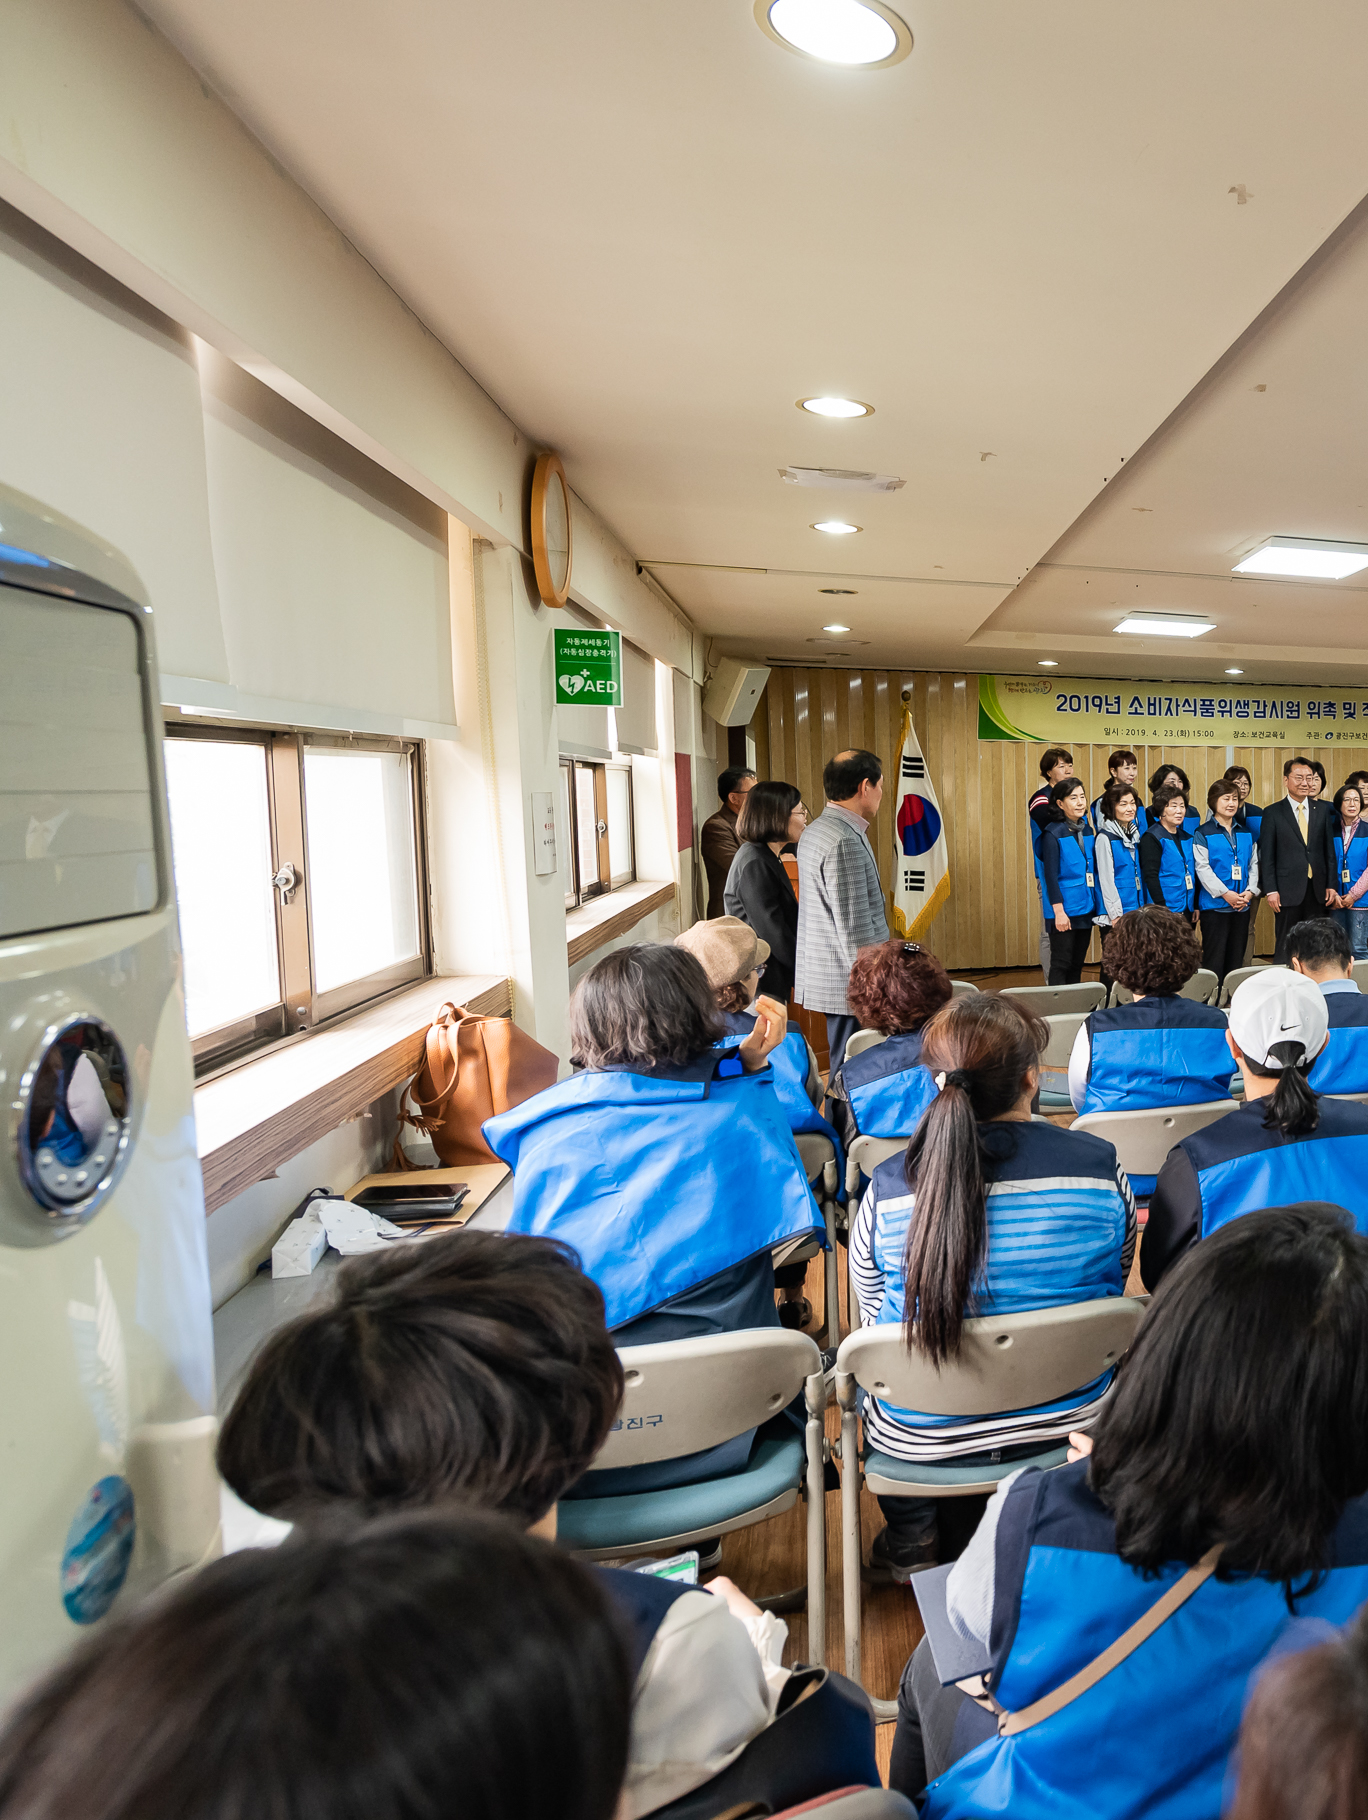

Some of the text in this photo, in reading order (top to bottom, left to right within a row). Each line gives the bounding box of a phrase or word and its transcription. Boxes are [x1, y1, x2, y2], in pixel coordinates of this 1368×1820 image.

[566, 637, 610, 647] 자동제세동기
[560, 648, 617, 658] (자동심장충격기)
[583, 680, 618, 693] AED
[1056, 693, 1121, 715] 2019년
[1127, 695, 1301, 720] 소비자식품위생감시원
[1306, 700, 1338, 720] 위촉
[1342, 701, 1357, 720] 및
[1192, 730, 1215, 738] 15:00
[1251, 731, 1286, 739] 보건교육실
